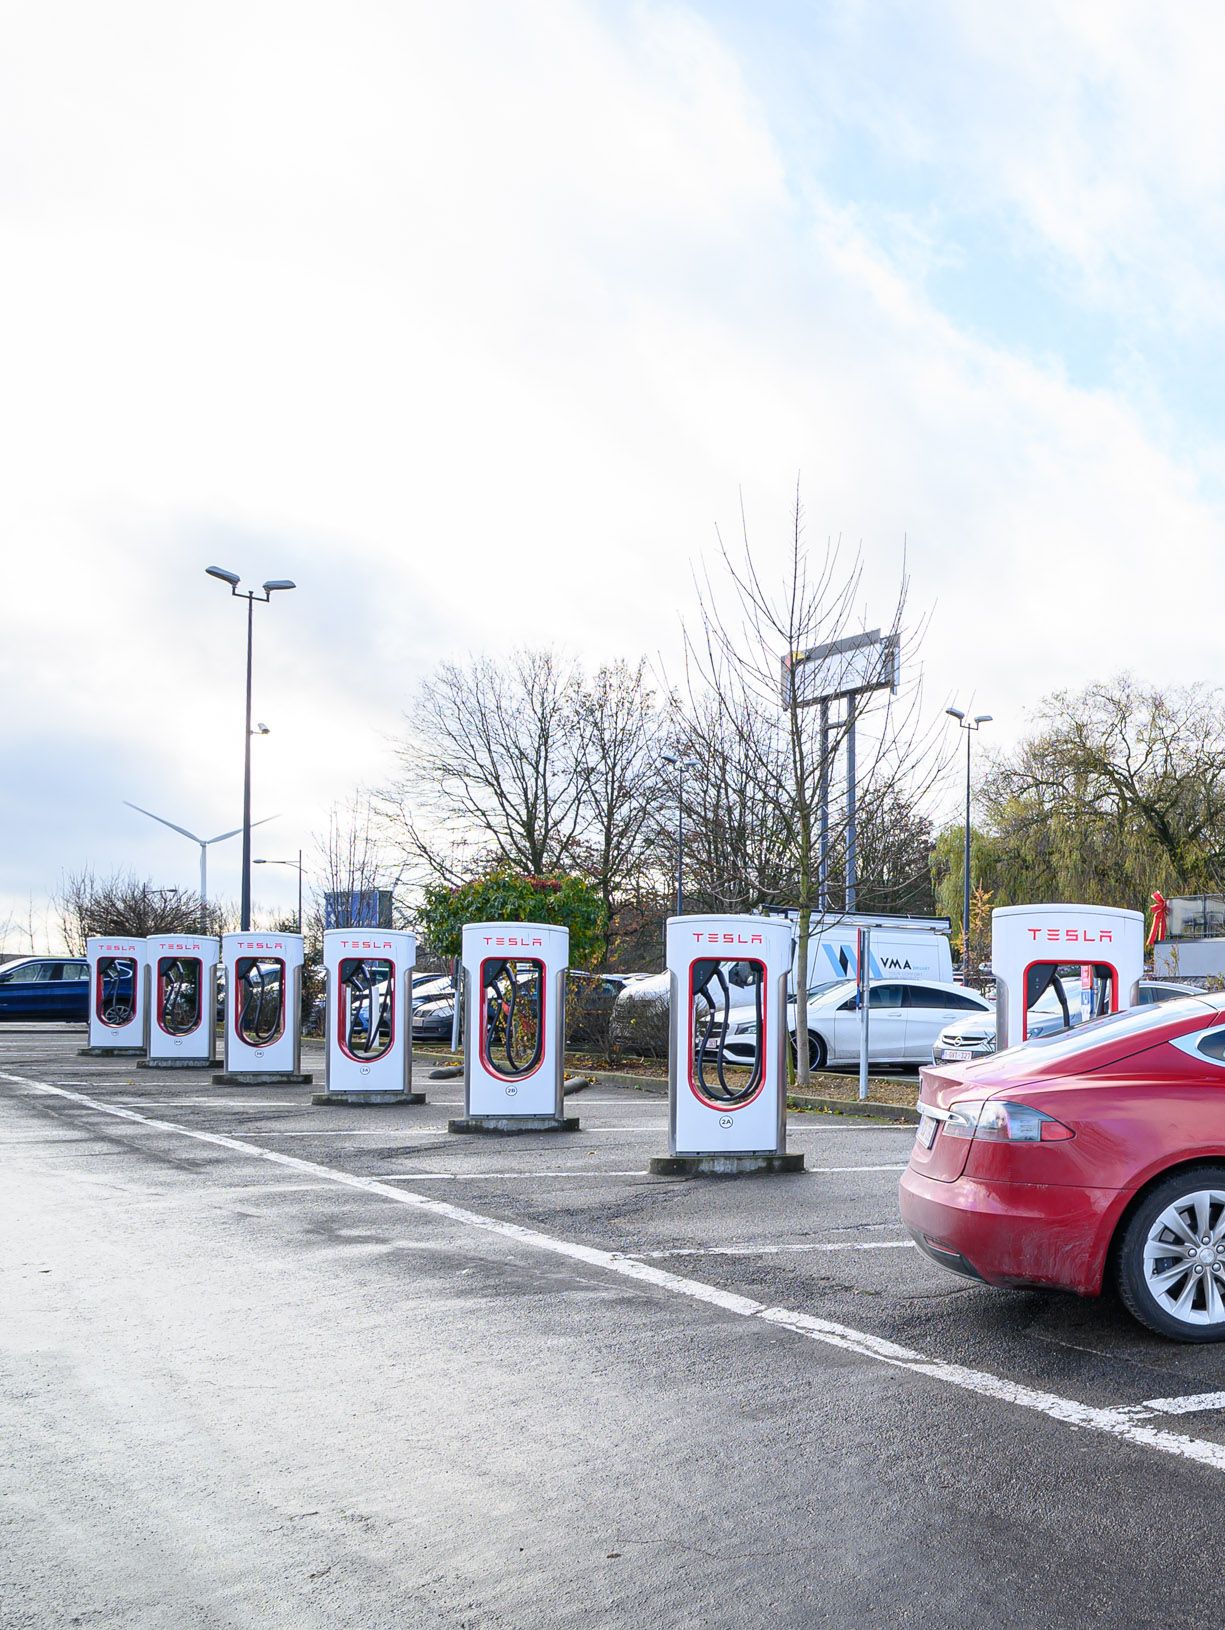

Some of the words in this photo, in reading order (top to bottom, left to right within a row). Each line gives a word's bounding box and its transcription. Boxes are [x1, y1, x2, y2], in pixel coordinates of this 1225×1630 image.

[692, 932, 763, 944] TESLA
[1027, 927, 1113, 943] TESLA
[340, 940, 393, 949] TESLA
[483, 936, 542, 947] TESLA
[880, 957, 912, 970] VMA
[721, 1118, 732, 1126] 2A
